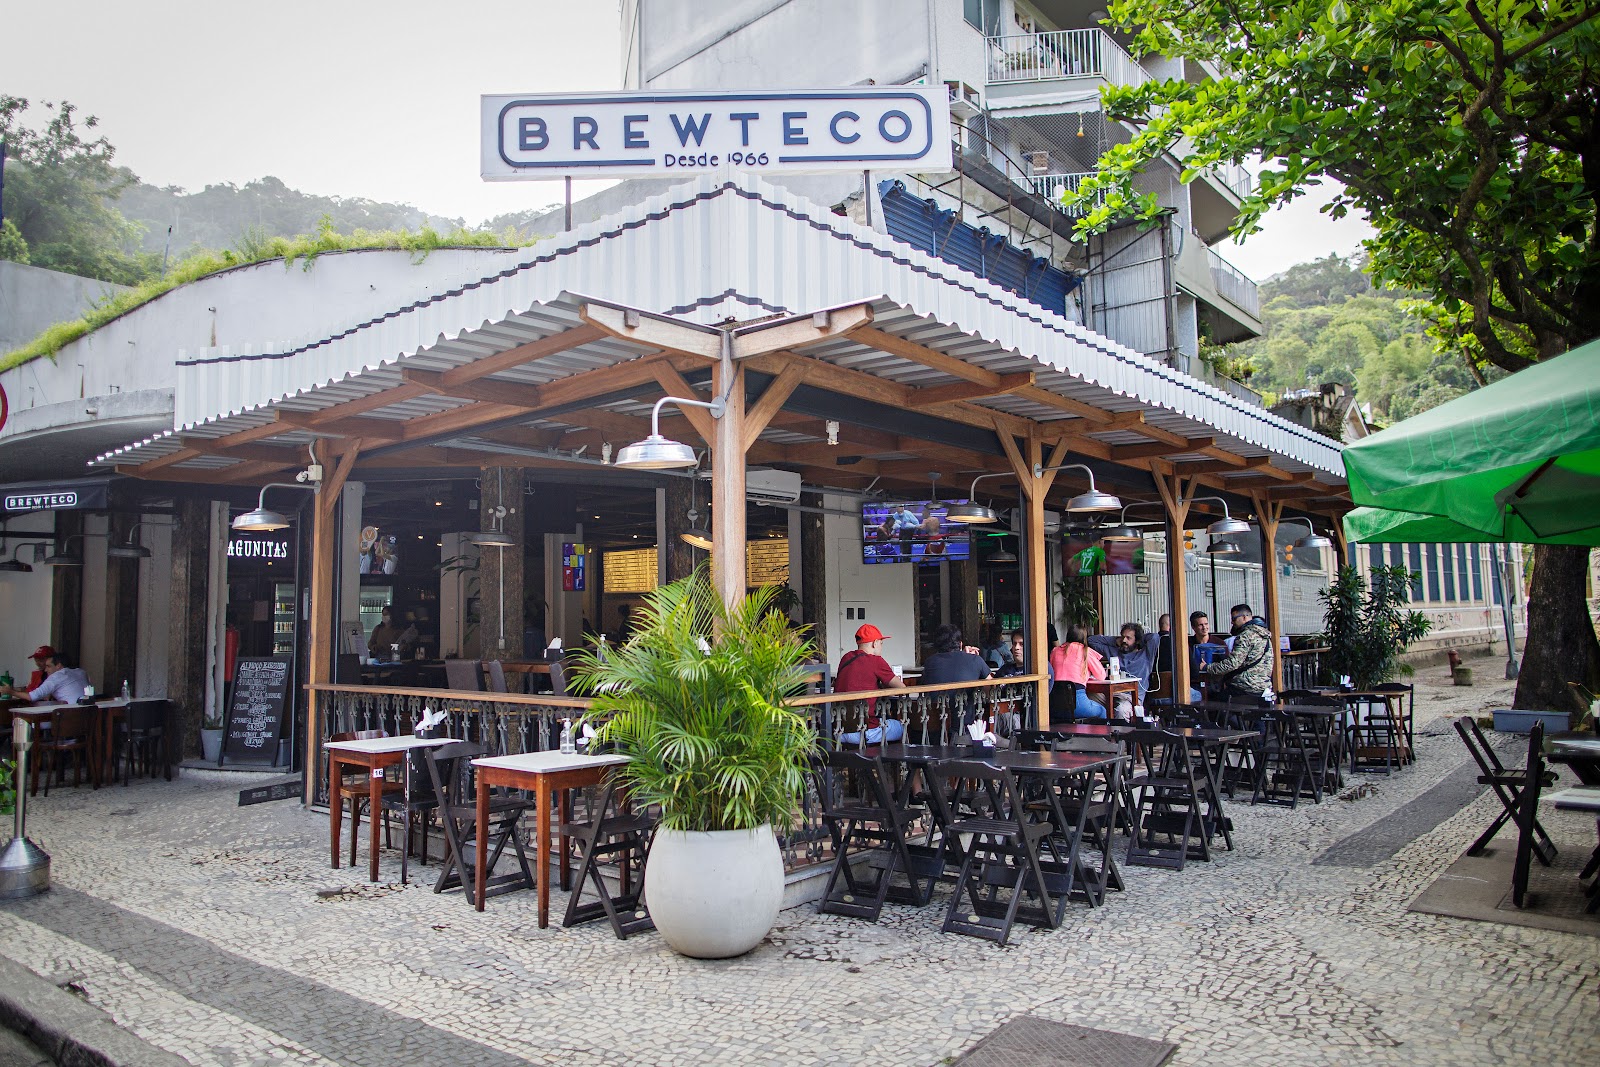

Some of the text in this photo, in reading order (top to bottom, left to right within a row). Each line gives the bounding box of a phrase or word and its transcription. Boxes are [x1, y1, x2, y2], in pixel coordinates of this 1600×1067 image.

[519, 109, 913, 151] BREWTECO
[664, 152, 769, 167] Desde 1966
[9, 495, 74, 507] BREWTECO
[1082, 556, 1093, 569] 17
